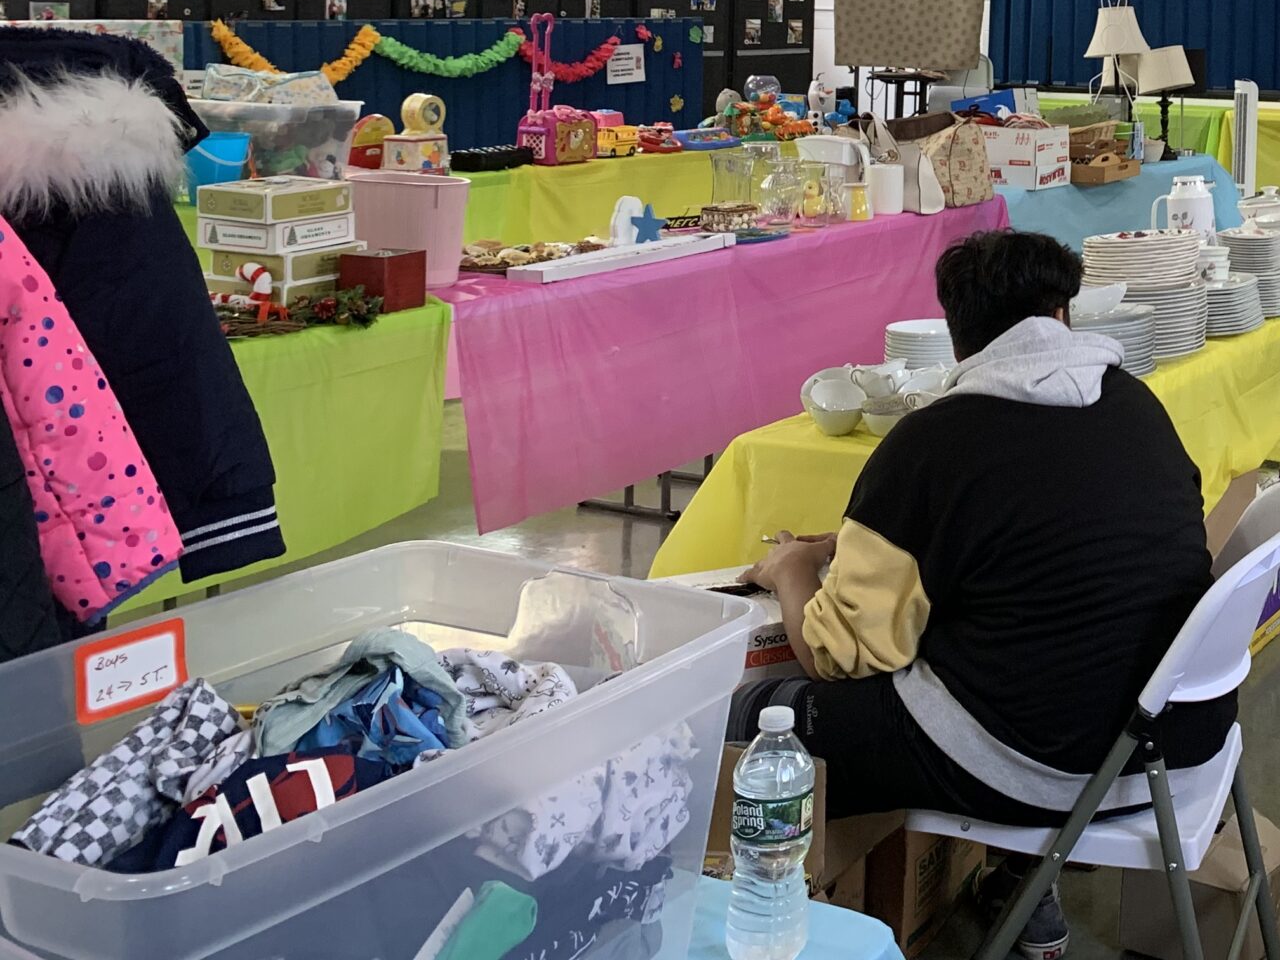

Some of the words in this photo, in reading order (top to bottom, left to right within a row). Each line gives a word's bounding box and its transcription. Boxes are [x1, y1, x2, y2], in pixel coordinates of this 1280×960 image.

[754, 633, 787, 648] Sysco
[733, 802, 764, 817] Poland
[733, 815, 765, 830] Spring
